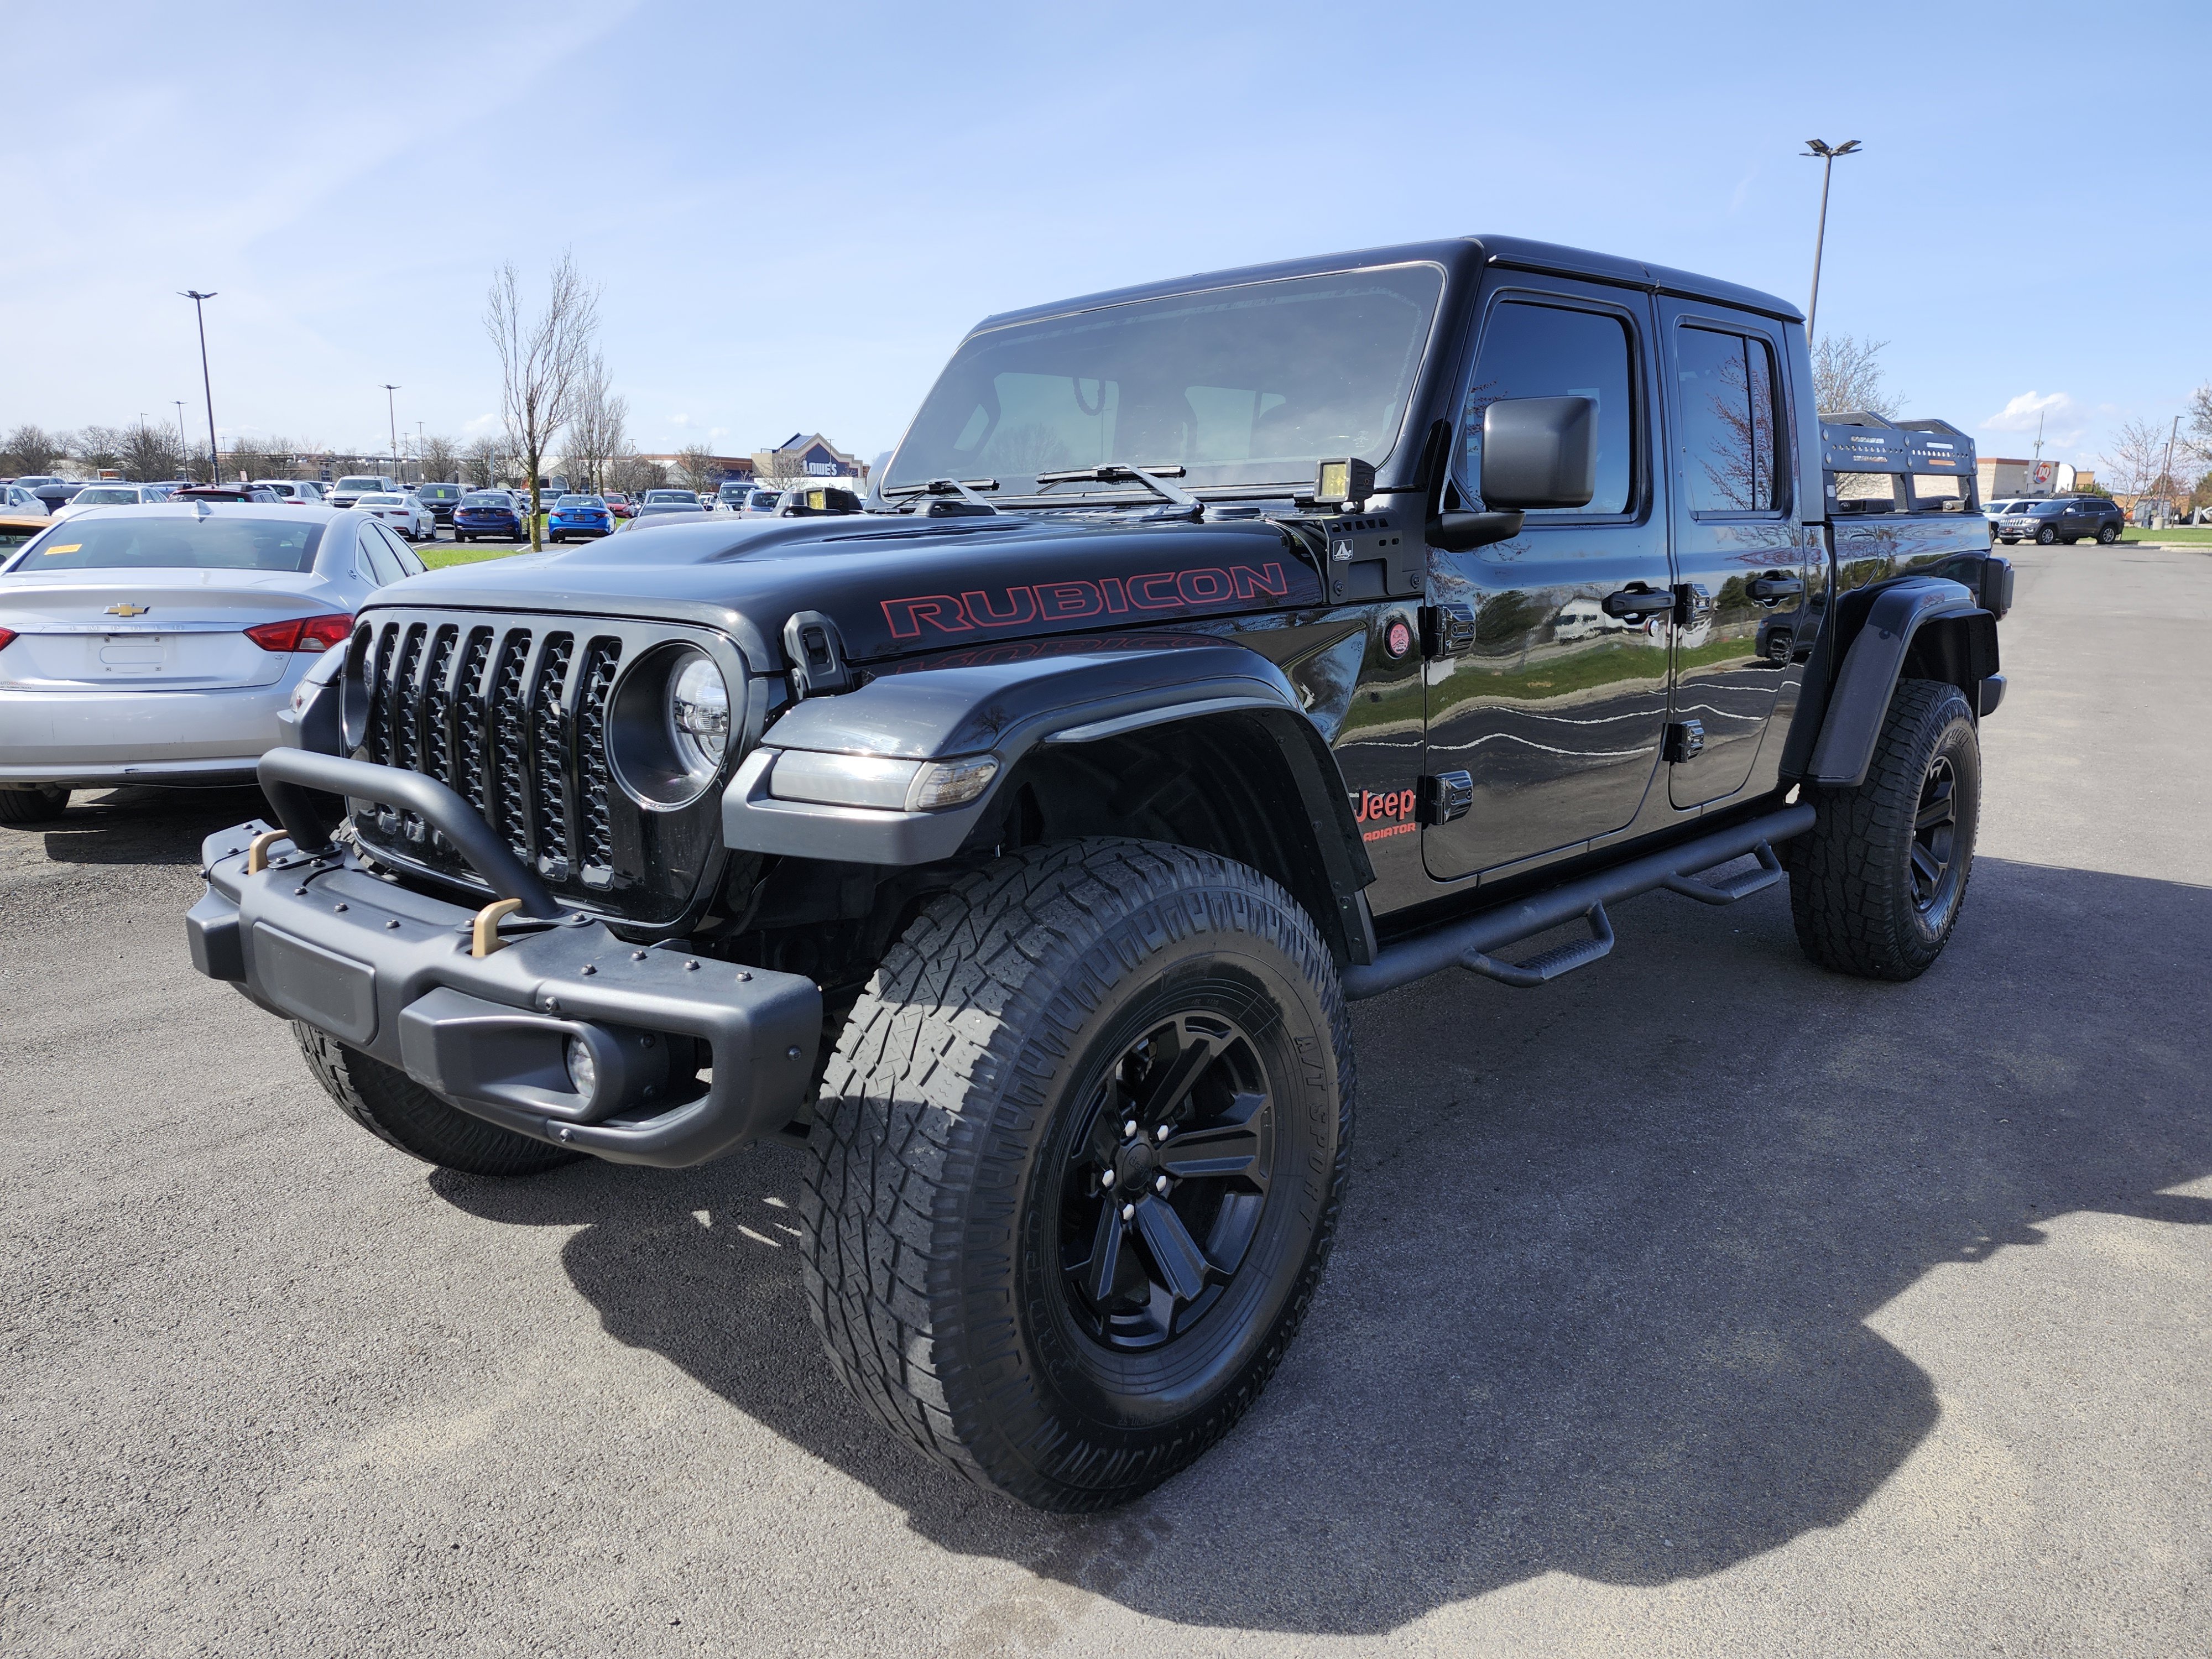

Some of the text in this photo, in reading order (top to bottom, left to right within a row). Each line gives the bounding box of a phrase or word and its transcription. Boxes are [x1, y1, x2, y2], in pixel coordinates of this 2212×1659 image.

[2038, 467, 2049, 478] DQ
[880, 563, 1288, 638] RUBICON
[1354, 789, 1415, 823] Jeep
[1363, 822, 1416, 842] ADIATOR
